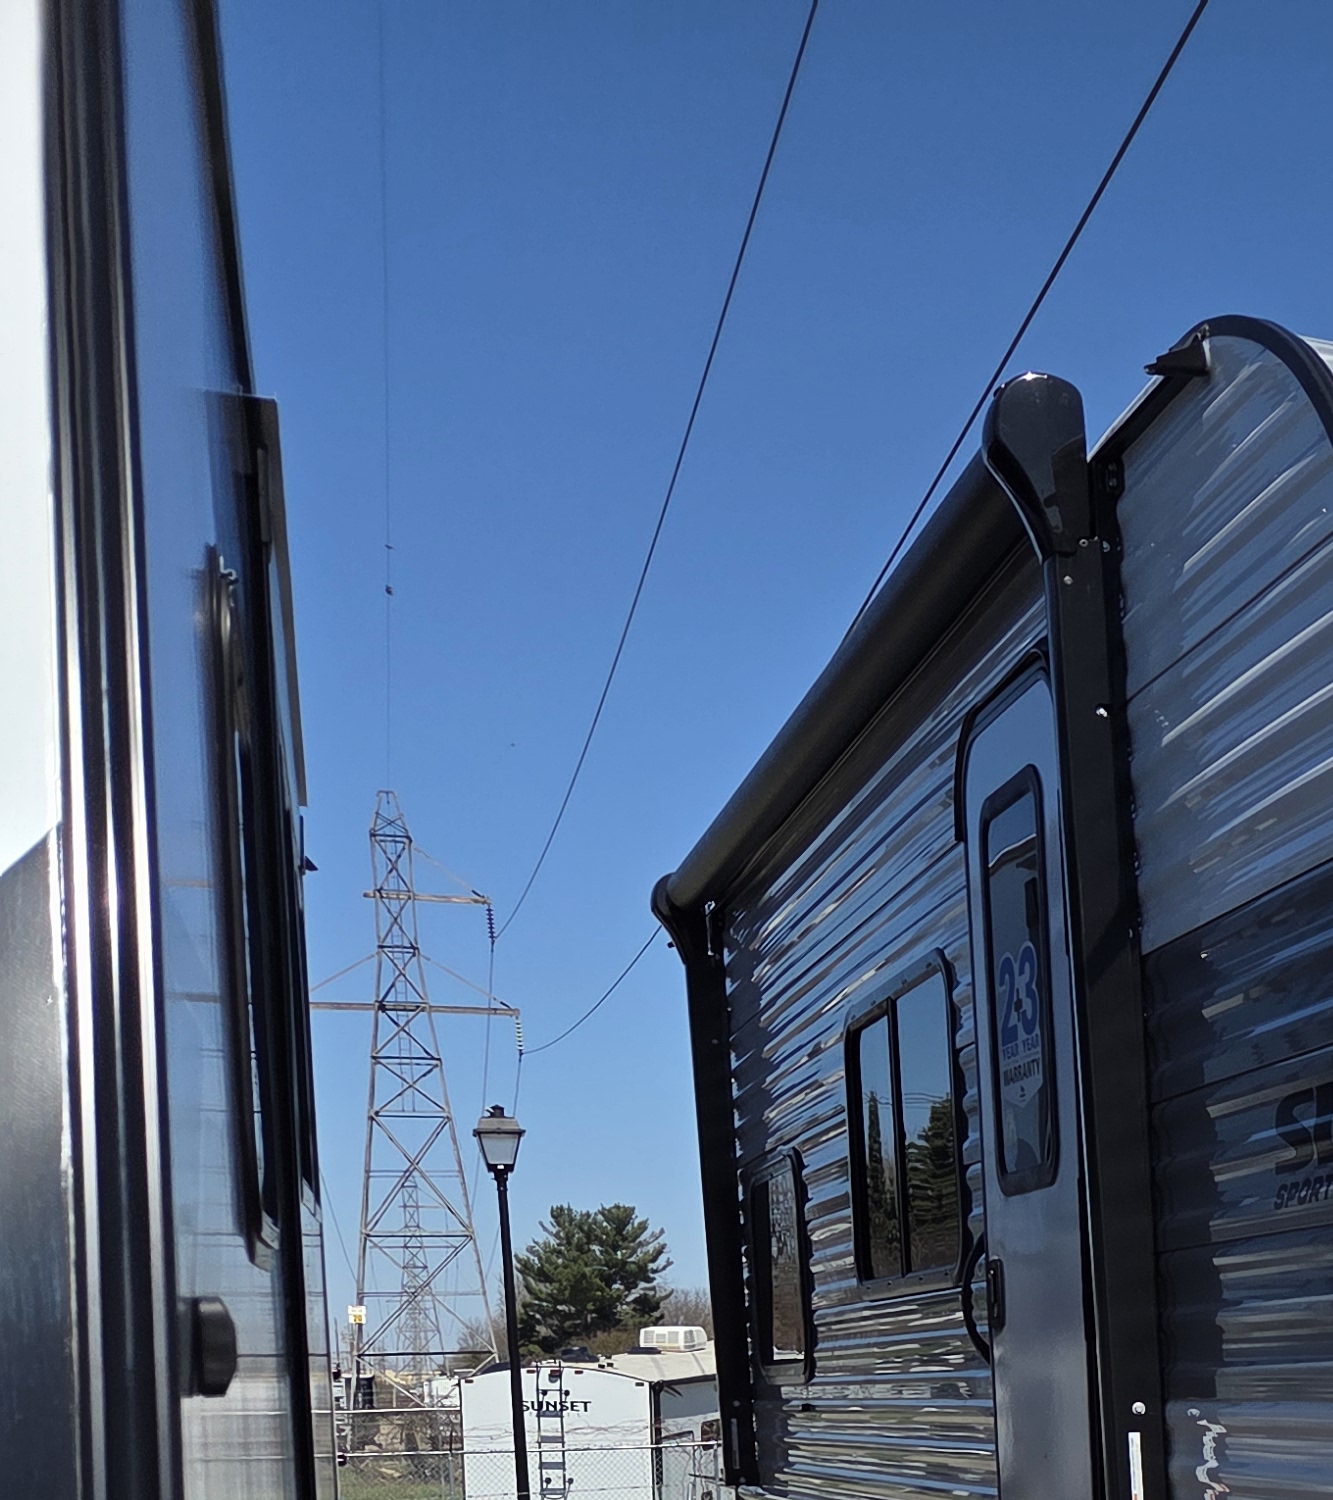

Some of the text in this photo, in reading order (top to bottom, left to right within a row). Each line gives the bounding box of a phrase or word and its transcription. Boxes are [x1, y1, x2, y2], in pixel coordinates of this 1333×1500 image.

[1002, 1042, 1019, 1062] YEAR
[1022, 1035, 1040, 1053] YEAR
[1003, 1056, 1041, 1087] WARRANTY
[522, 1400, 592, 1413] SUNSET
